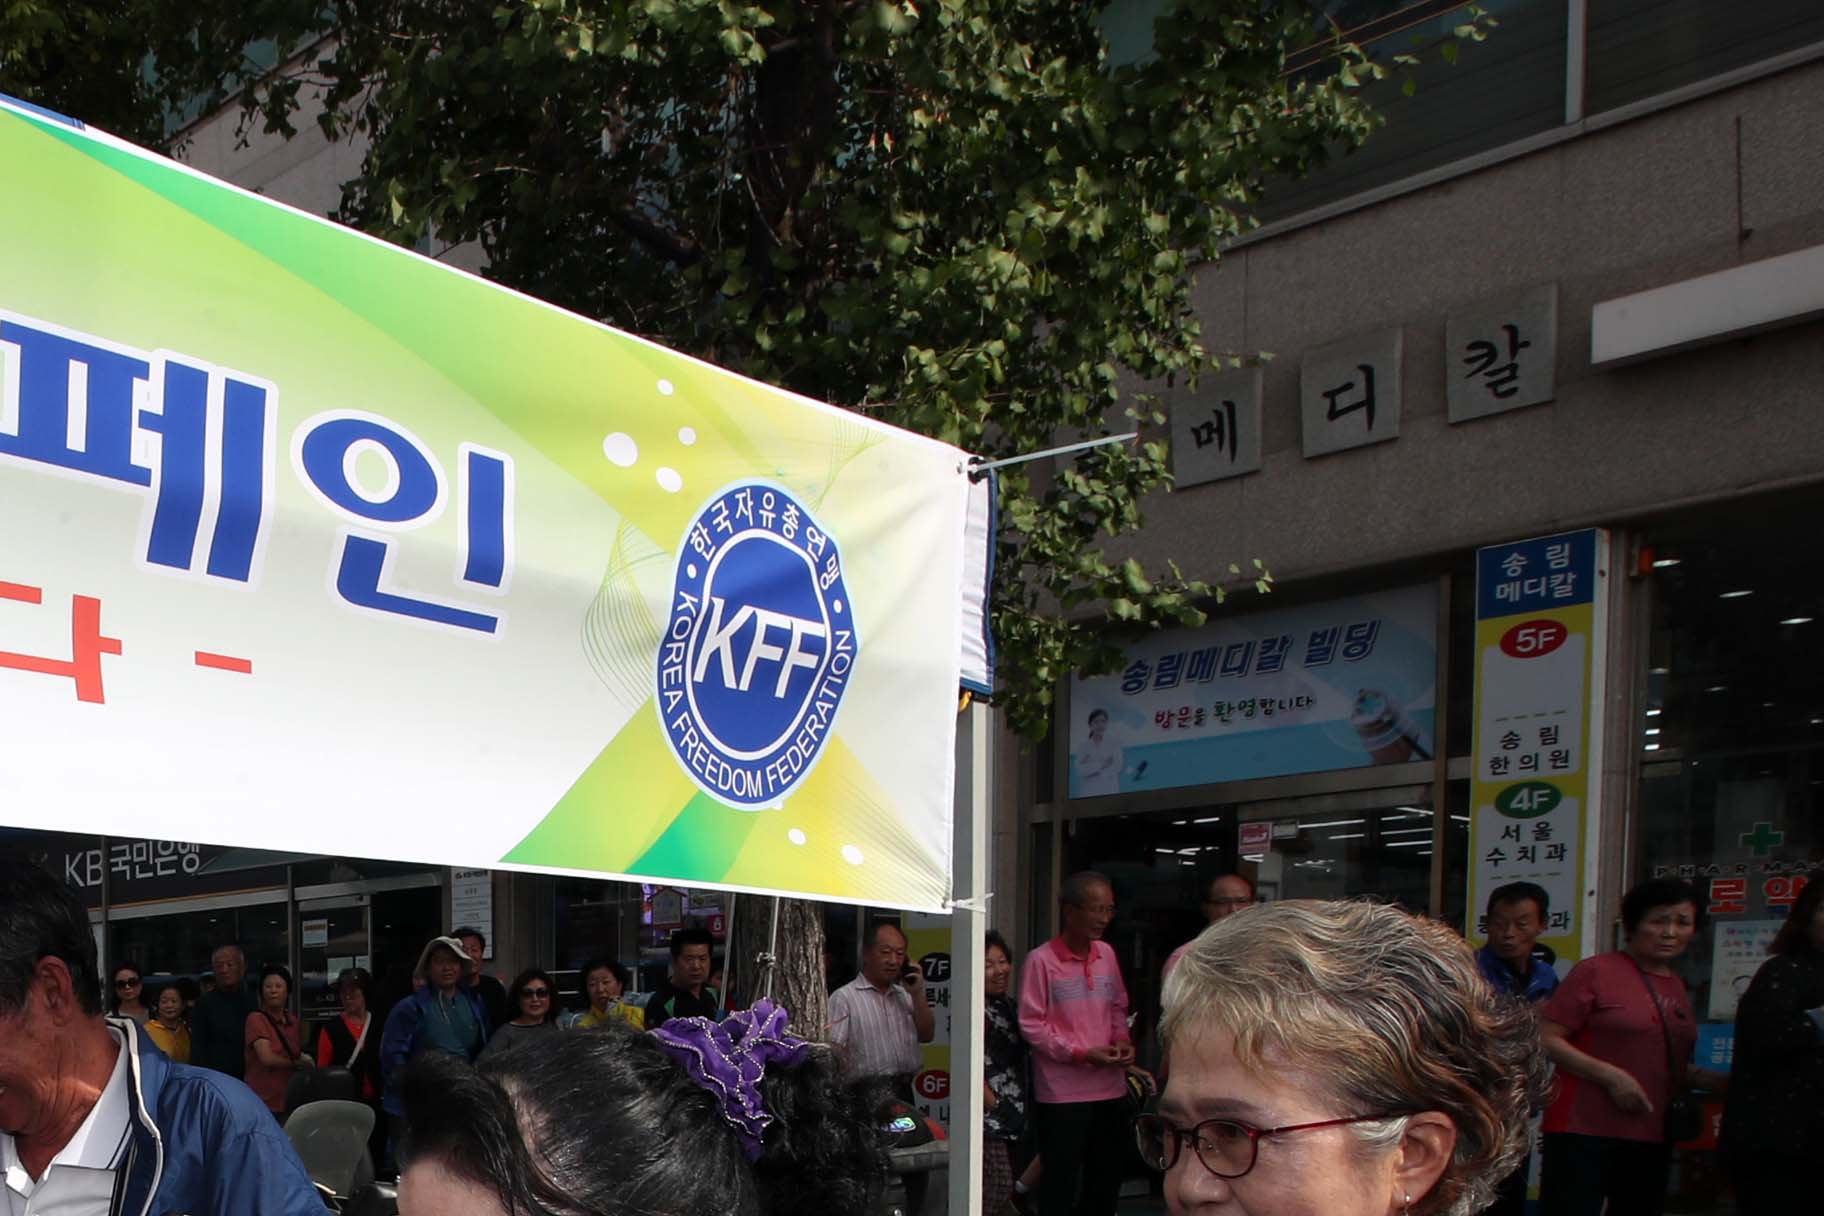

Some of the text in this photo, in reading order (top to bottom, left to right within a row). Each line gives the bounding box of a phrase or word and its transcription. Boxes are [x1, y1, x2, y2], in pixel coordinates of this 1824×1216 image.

[689, 487, 840, 591] 한국자유총연맹
[1495, 571, 1577, 602] 메디칼
[693, 596, 826, 700] KFF
[1515, 627, 1558, 653] 5F
[1120, 619, 1383, 697] 송림메디칼 빌딩
[662, 591, 852, 800] KOREA FREEDOM FEDERATION
[1509, 788, 1551, 812] 4F
[924, 957, 950, 977] 7F
[923, 1074, 948, 1094] 6F
